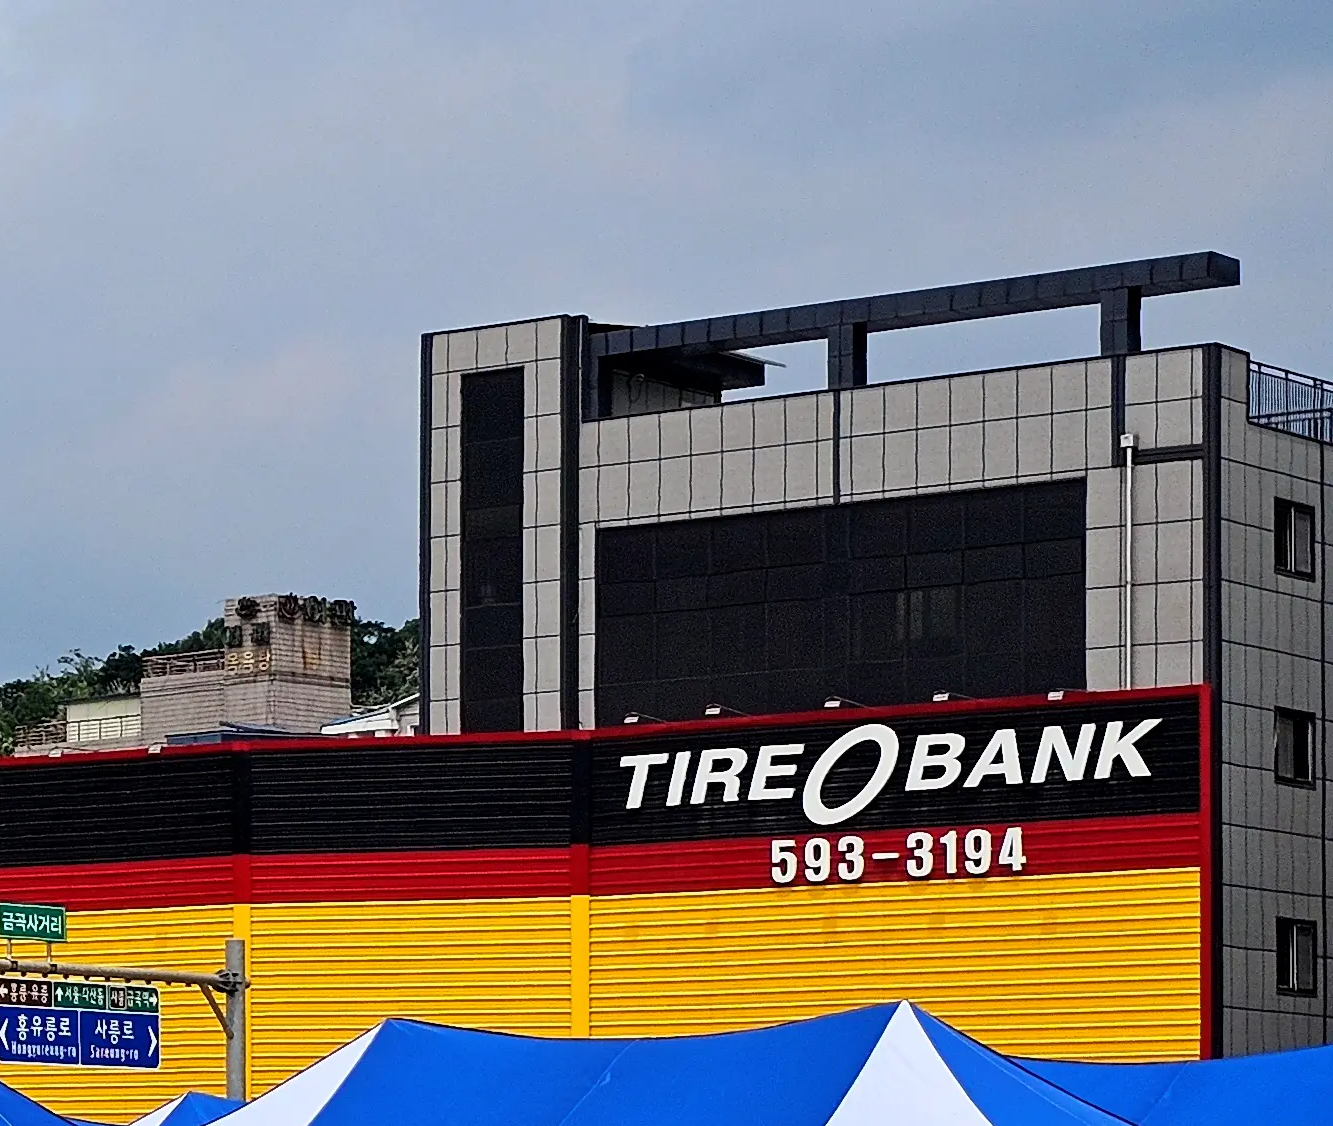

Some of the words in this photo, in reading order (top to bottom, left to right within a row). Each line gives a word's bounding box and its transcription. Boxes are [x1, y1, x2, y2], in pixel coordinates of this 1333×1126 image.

[770, 827, 1027, 884] 593-3194
[2, 912, 62, 935] 금곡사거리
[16, 1014, 72, 1042] 홍유릉로
[94, 1019, 135, 1045] 사릉로
